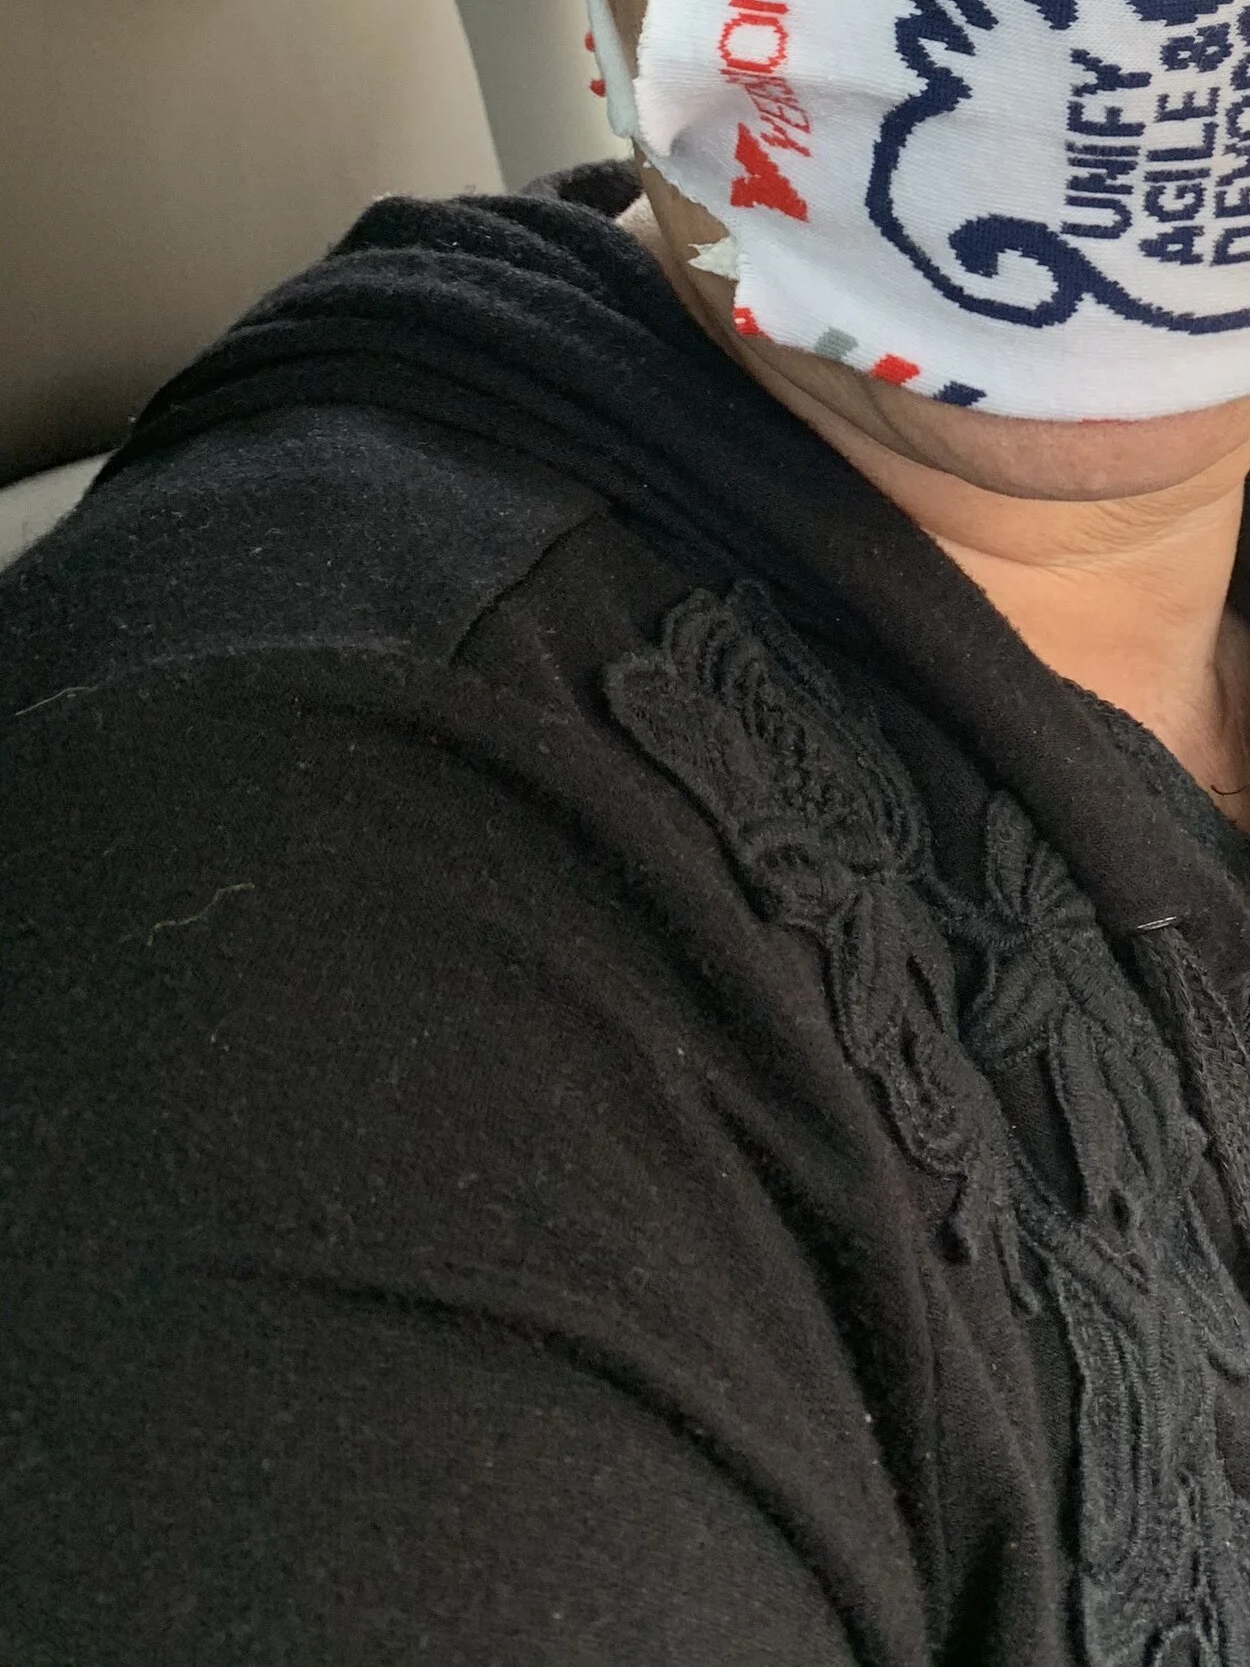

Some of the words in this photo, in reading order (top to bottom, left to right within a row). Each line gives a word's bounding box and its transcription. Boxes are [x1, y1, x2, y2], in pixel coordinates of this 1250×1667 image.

[1160, 23, 1233, 73] &
[1061, 48, 1152, 239] UNIFY
[1138, 87, 1220, 266] AGILE
